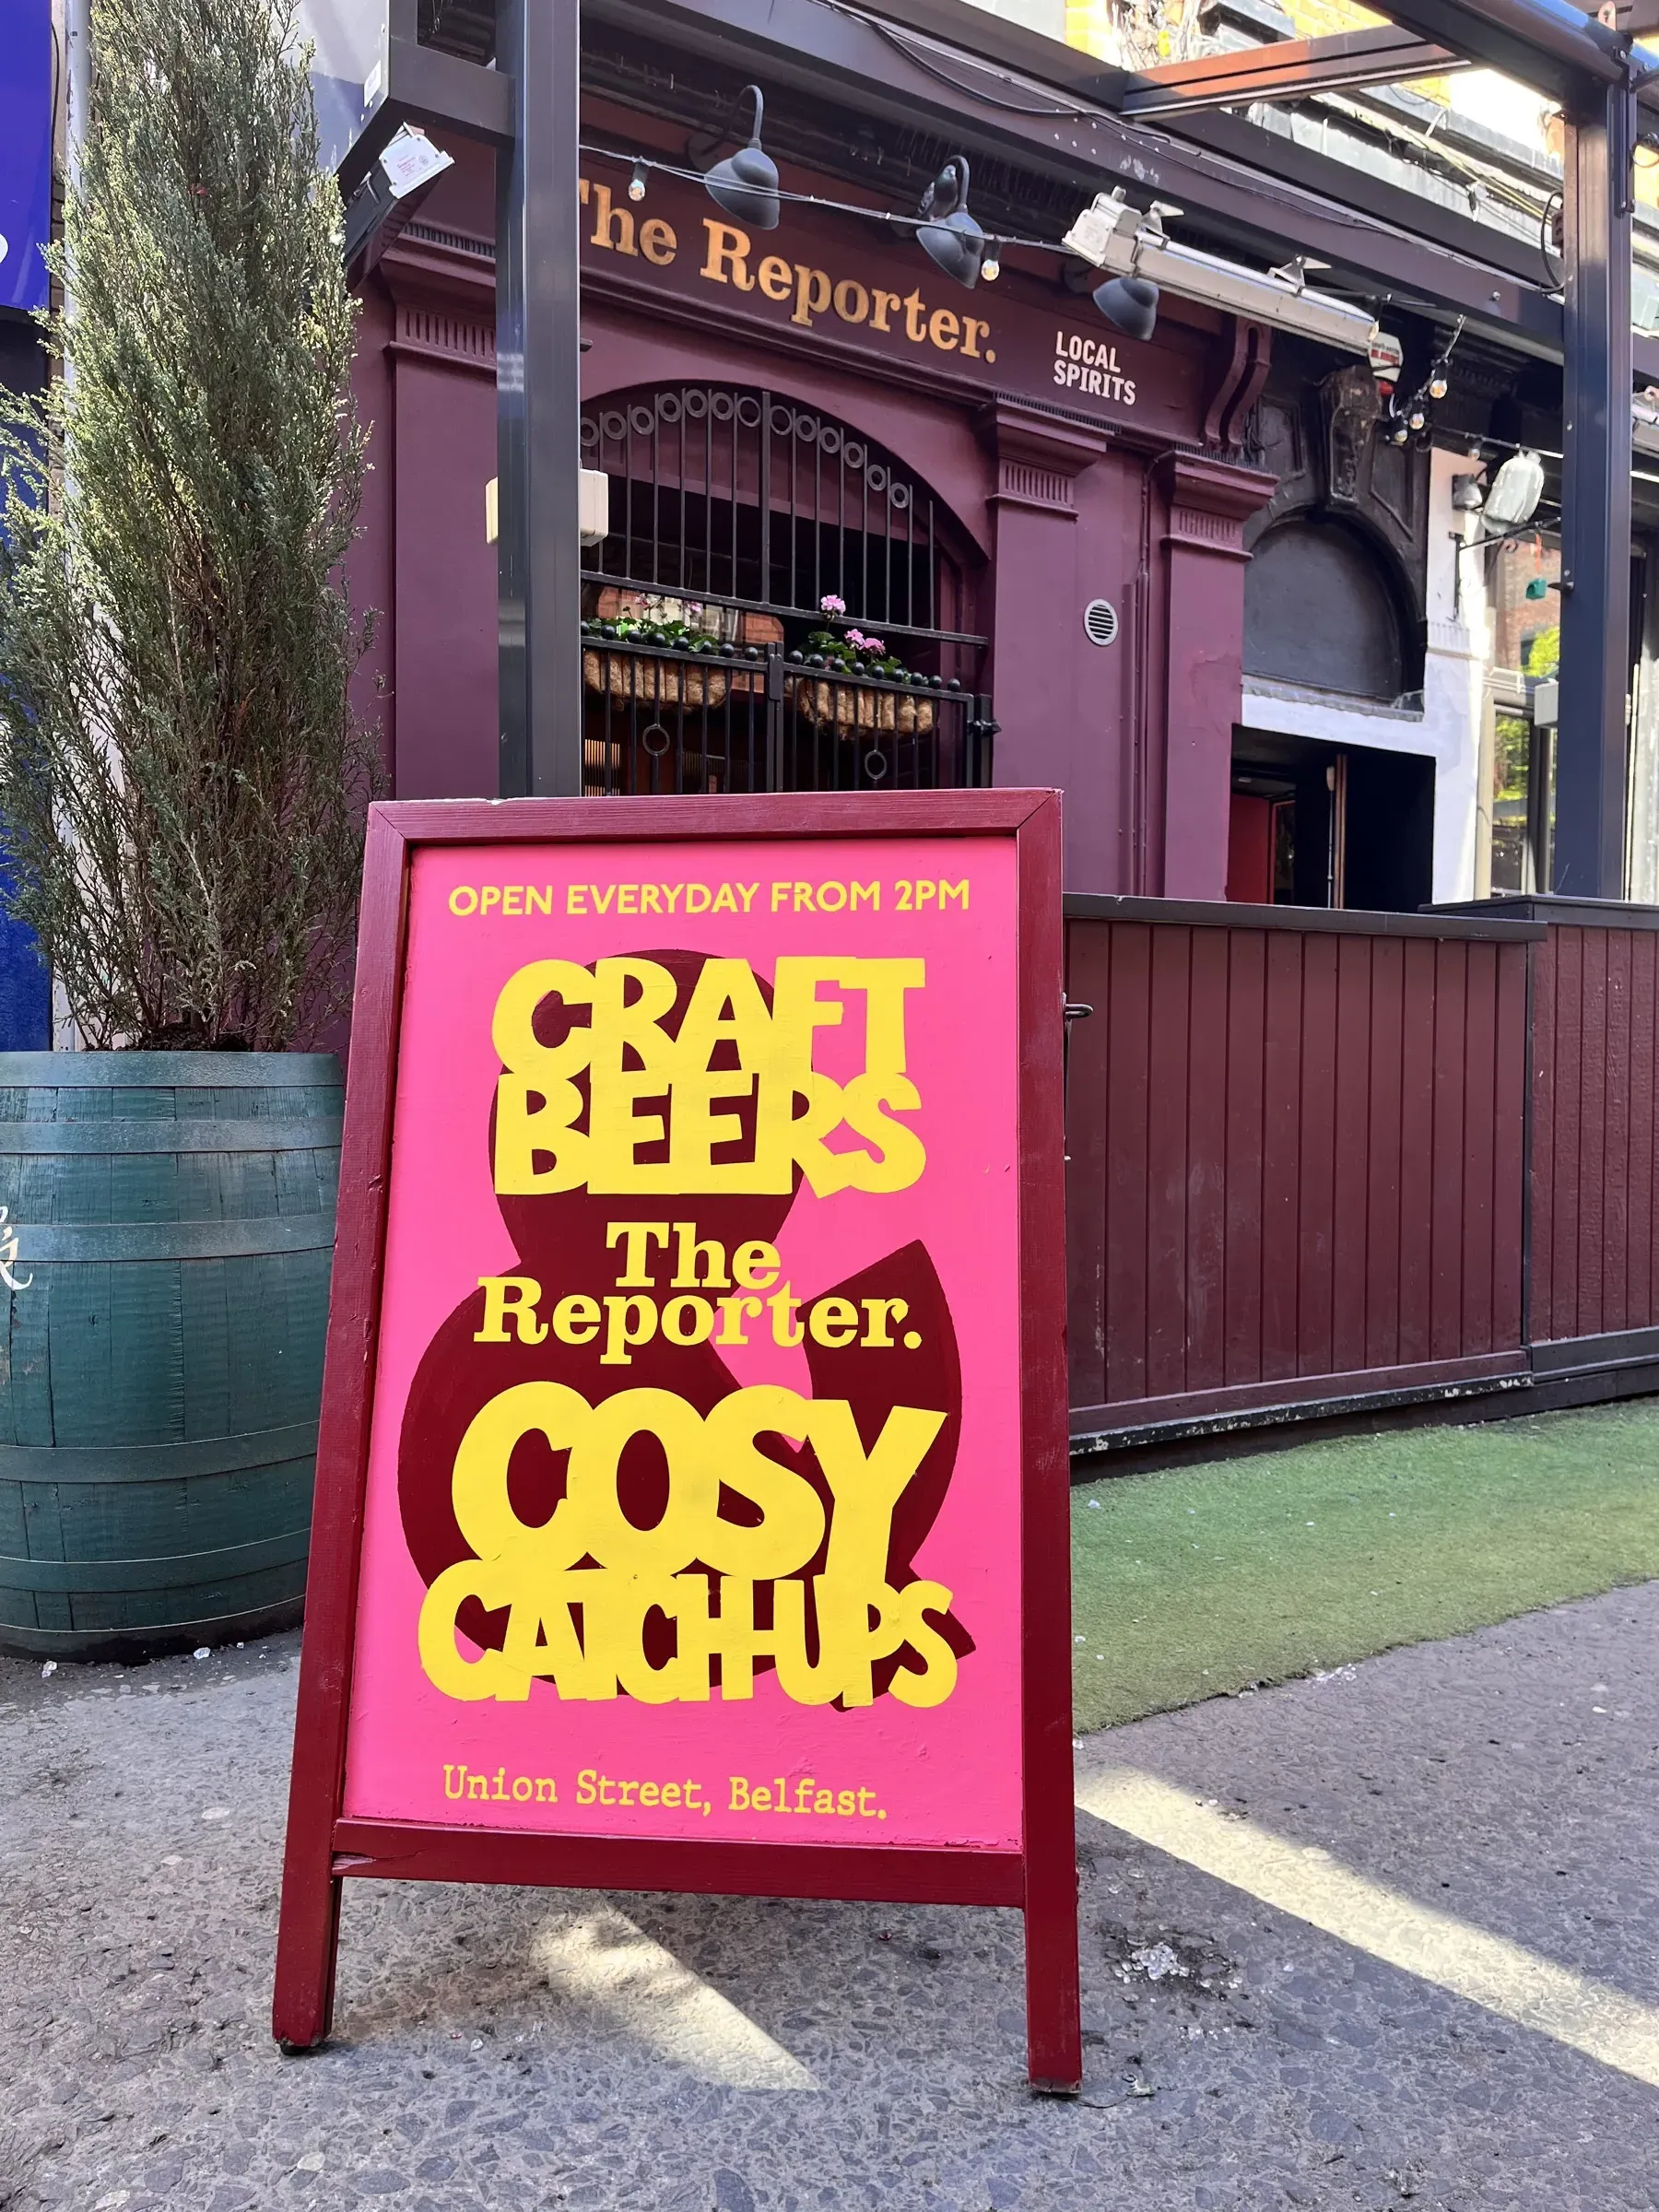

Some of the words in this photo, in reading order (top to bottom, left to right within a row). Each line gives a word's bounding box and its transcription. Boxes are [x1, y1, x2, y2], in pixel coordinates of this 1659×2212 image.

[700, 218, 996, 364] Reporter.
[1053, 359, 1136, 406] SPIRITS
[1055, 331, 1121, 373] LOCAL
[449, 886, 553, 916] OPEN
[567, 882, 759, 915] EVERYDAY
[771, 880, 881, 912] FROM
[894, 879, 971, 912] 2PM
[491, 956, 926, 1078] CRAFT
[494, 1069, 927, 1199] BEERS
[606, 1221, 782, 1289] The
[473, 1276, 923, 1365] Reporter.
[452, 1381, 947, 1582] COSY
[418, 1559, 959, 1709] CATCHUPS
[443, 1765, 559, 1804] Union
[576, 1769, 712, 1818] Street,
[728, 1776, 888, 1820] Belfast.
